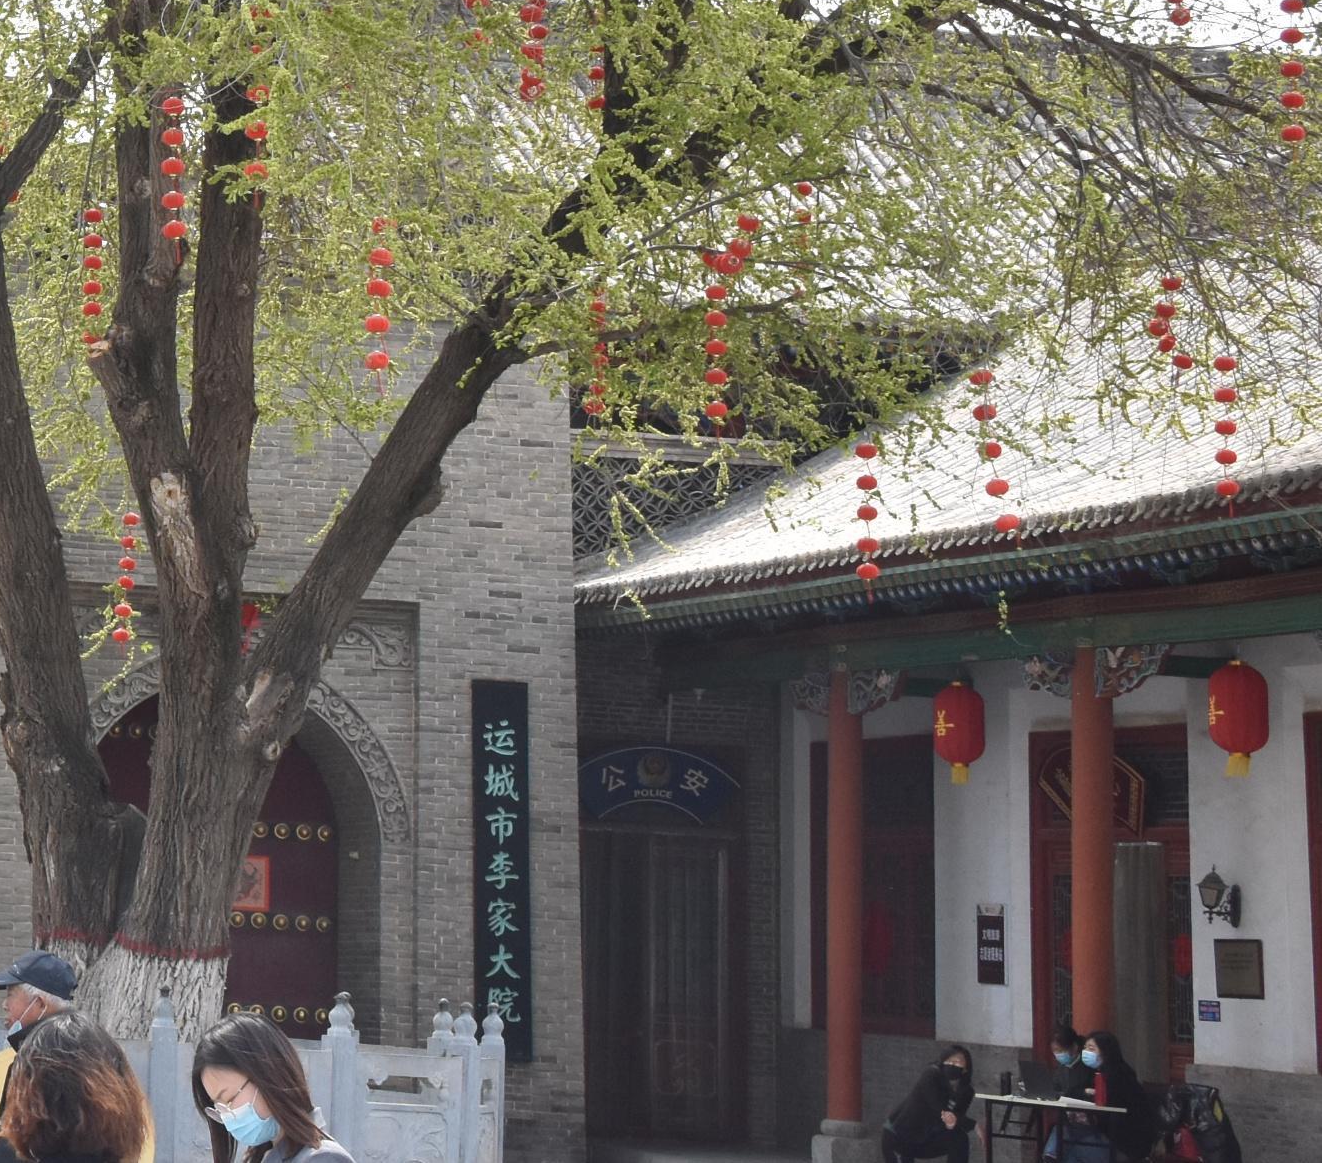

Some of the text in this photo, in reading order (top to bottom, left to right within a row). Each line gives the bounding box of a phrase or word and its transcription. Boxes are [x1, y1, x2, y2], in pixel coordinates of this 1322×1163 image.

[483, 720, 522, 1023] 运城市李家大院
[634, 788, 674, 799] POLICE
